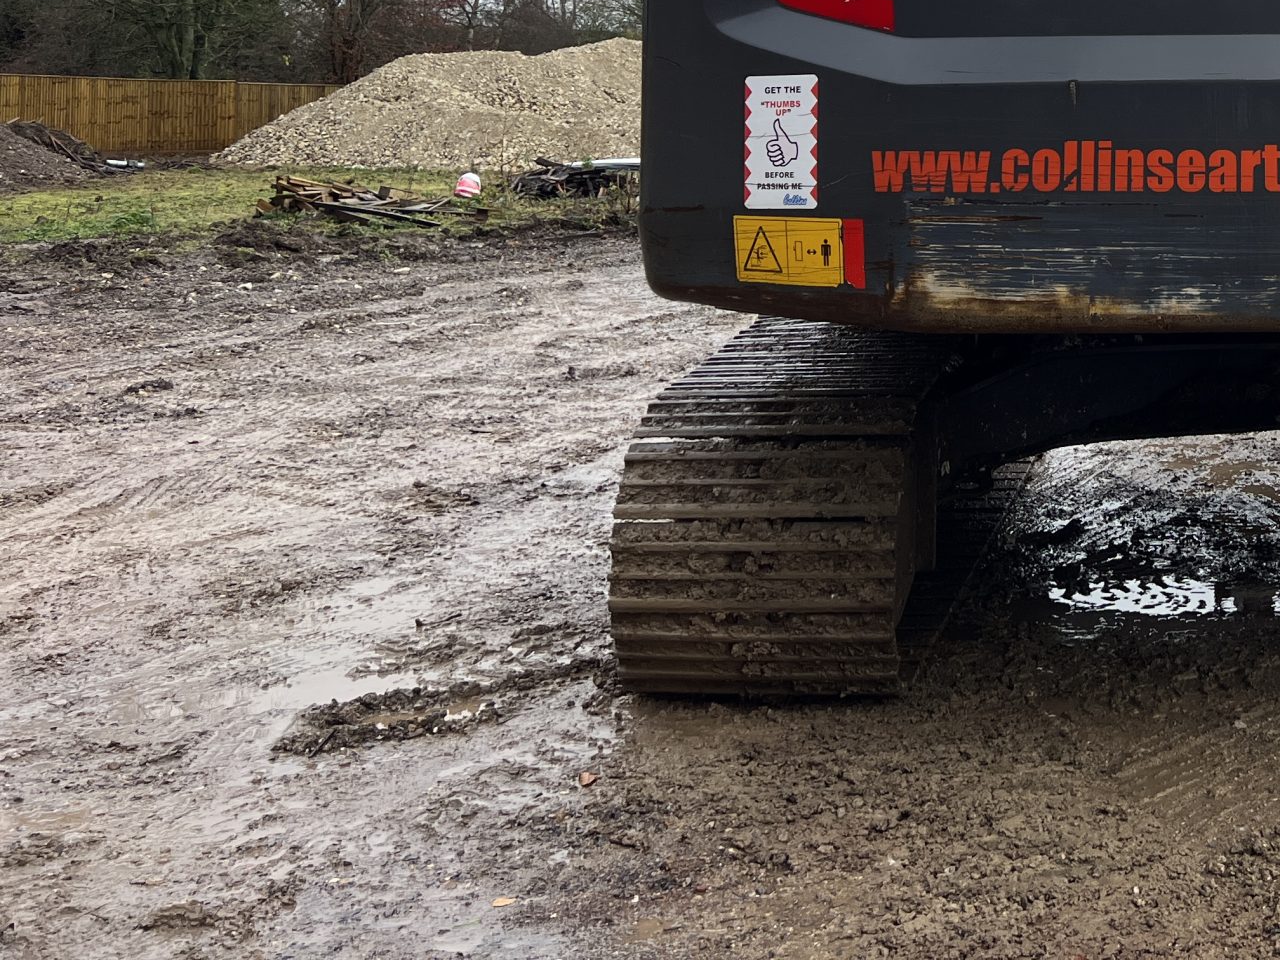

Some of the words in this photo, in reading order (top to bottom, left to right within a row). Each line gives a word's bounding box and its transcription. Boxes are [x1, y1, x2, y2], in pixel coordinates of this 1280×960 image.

[764, 86, 782, 94] GET
[783, 85, 802, 93] THE
[760, 100, 801, 108] "THUMBS
[764, 171, 795, 179] BEFORE
[756, 182, 789, 190] PASSING
[791, 182, 803, 190] ME
